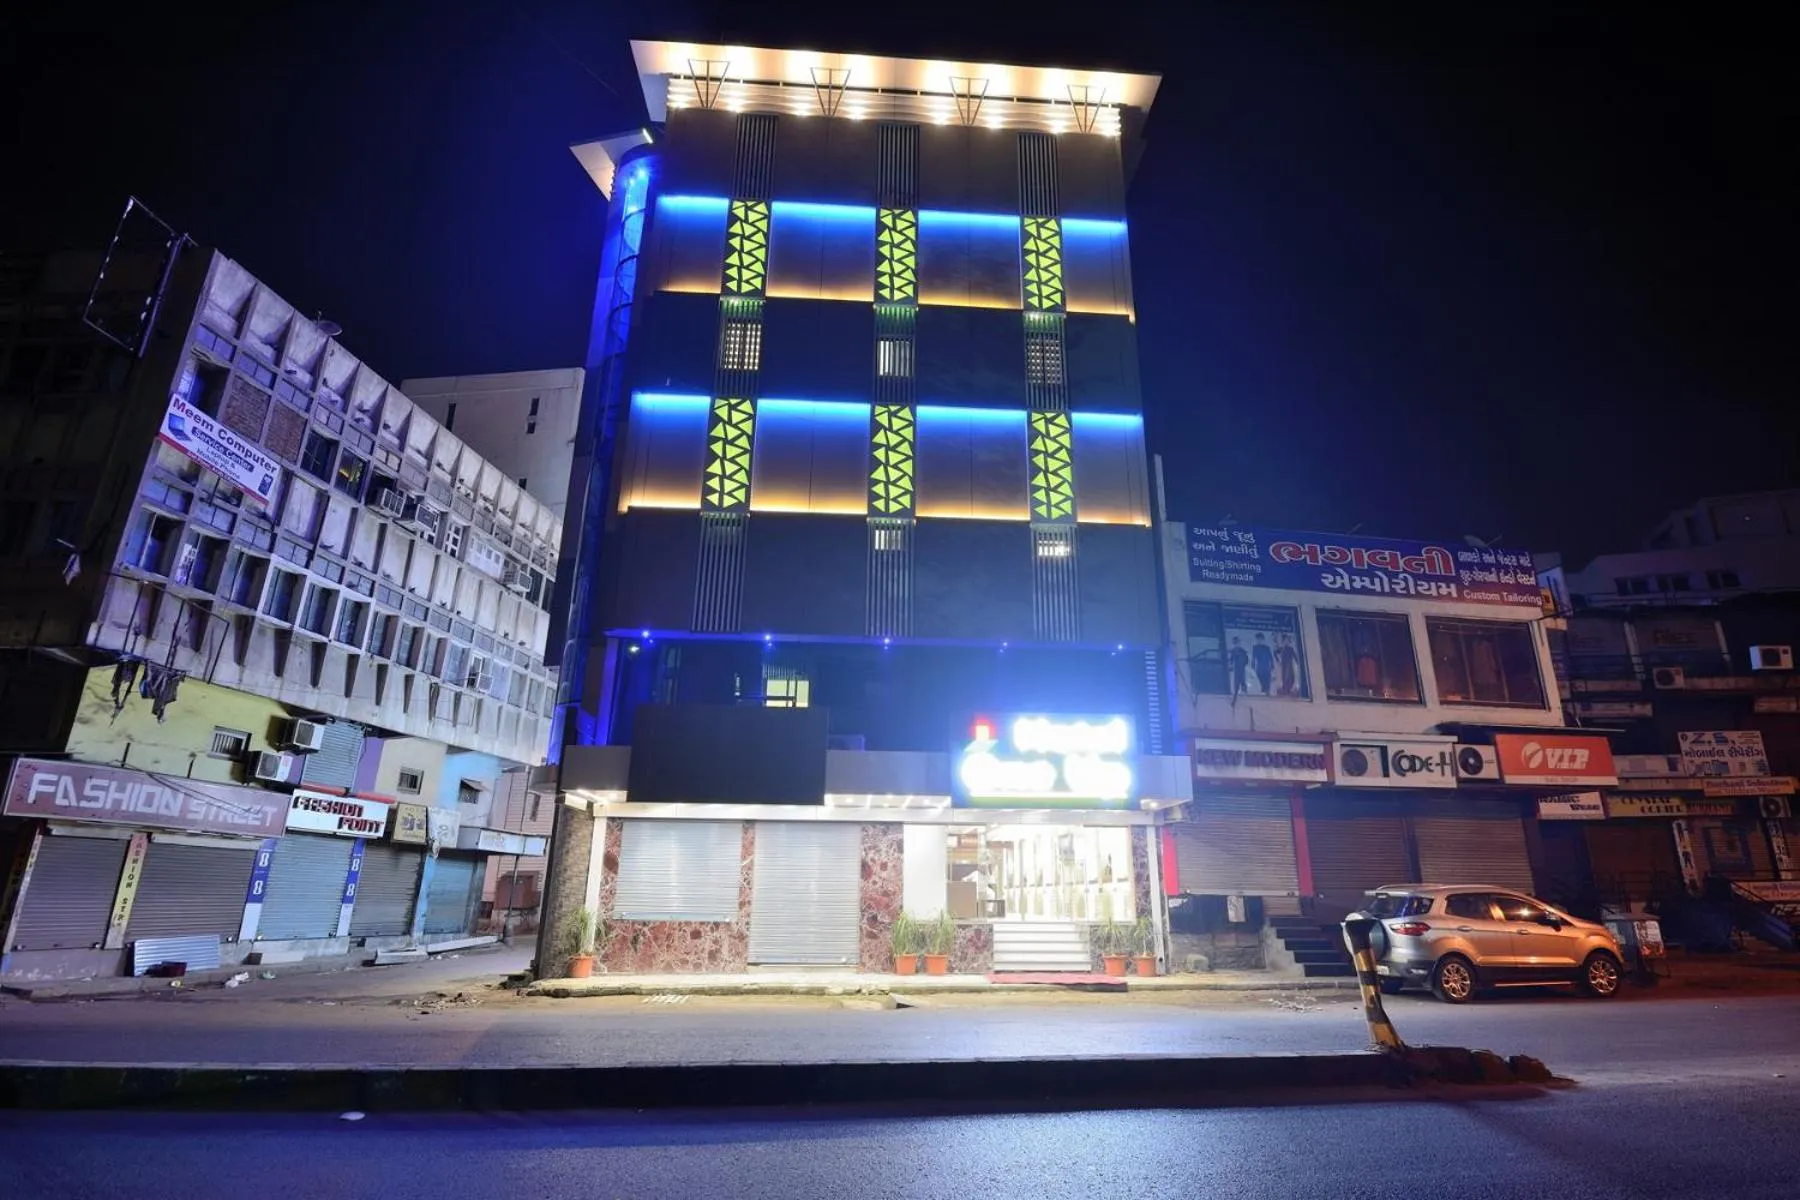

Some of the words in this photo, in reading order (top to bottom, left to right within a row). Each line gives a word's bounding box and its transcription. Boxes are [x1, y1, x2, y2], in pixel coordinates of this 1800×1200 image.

[173, 398, 214, 432] Meem
[218, 428, 278, 473] Computer
[1268, 540, 1457, 577] ભગવતી
[1201, 569, 1254, 582] Readymade
[1320, 568, 1458, 599] એમ્પોરીયમ
[1463, 589, 1501, 602] Custom
[1502, 592, 1543, 606] Tailoring
[1196, 748, 1242, 767] NEW
[1243, 749, 1327, 770] MODERN
[27, 772, 185, 817] FASHION
[187, 798, 278, 827] STREET
[292, 796, 364, 817] FASHION
[337, 816, 385, 834] POINT
